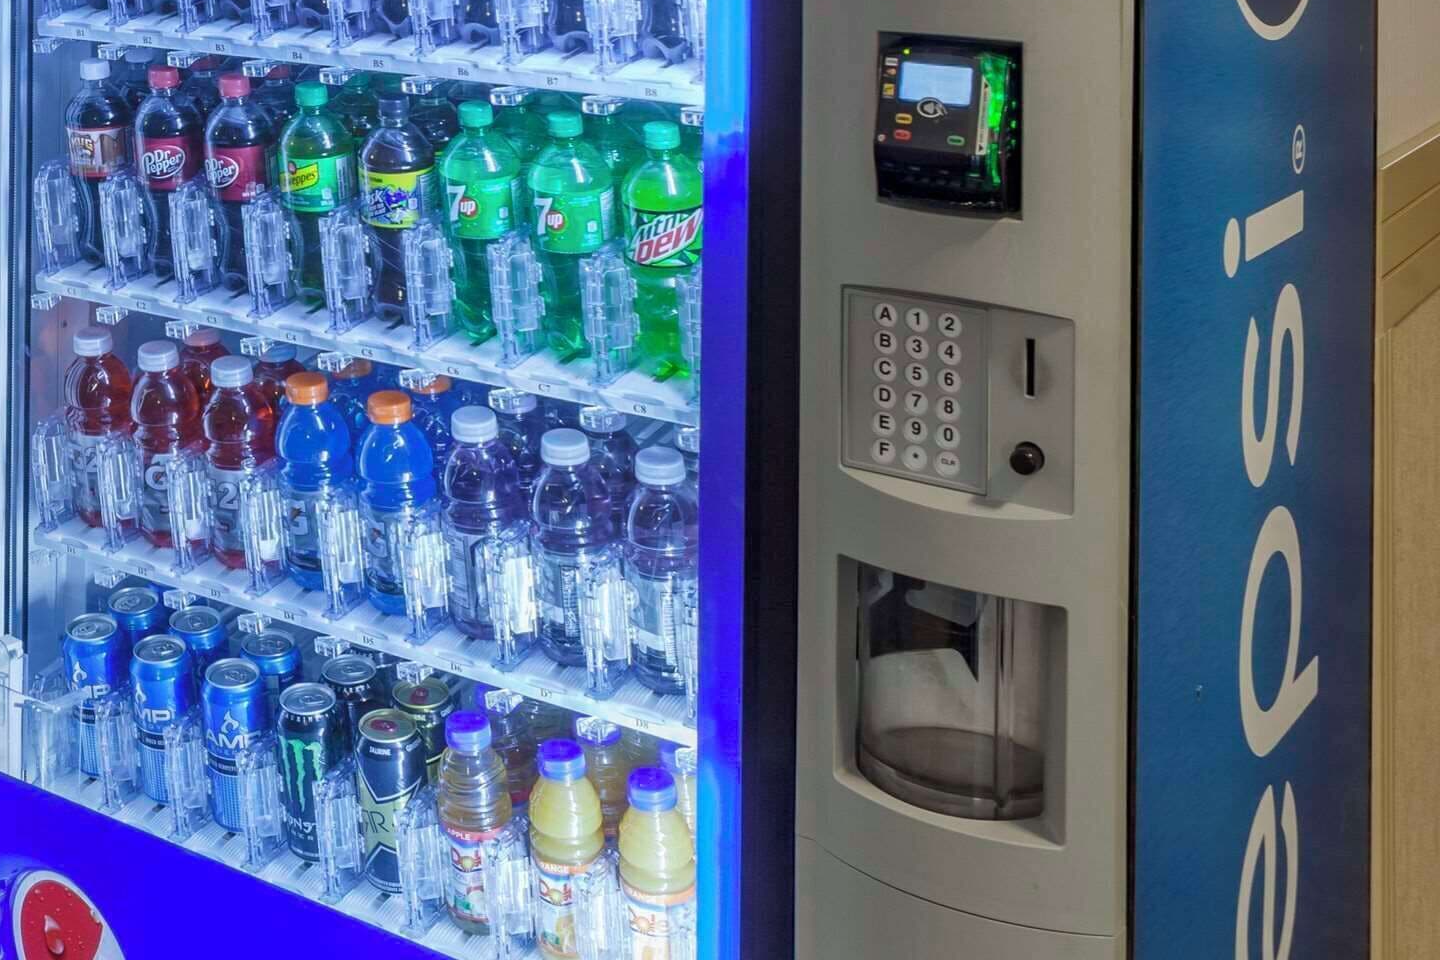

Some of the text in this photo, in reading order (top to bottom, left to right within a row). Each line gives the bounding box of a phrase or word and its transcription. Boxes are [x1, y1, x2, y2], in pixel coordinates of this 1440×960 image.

[76, 28, 85, 37] B1
[143, 36, 152, 45] B2
[215, 43, 225, 52] B3
[292, 51, 303, 60] B4
[373, 59, 384, 69] B5
[457, 68, 470, 77] B6
[547, 76, 559, 86] B7
[645, 87, 658, 97] B8
[154, 149, 171, 160] Dr
[143, 152, 182, 175] Pepper
[136, 301, 147, 309] C2
[879, 307, 955, 331] A 1 2
[880, 334, 954, 359] B 3 4
[361, 348, 373, 358] C5
[447, 366, 460, 376] C6
[879, 361, 954, 386] C 5 6
[537, 383, 551, 393] C7
[879, 388, 953, 414] D 7 8
[633, 403, 647, 414] C8
[879, 415, 953, 442] E 9 0
[879, 443, 956, 467] F CLR
